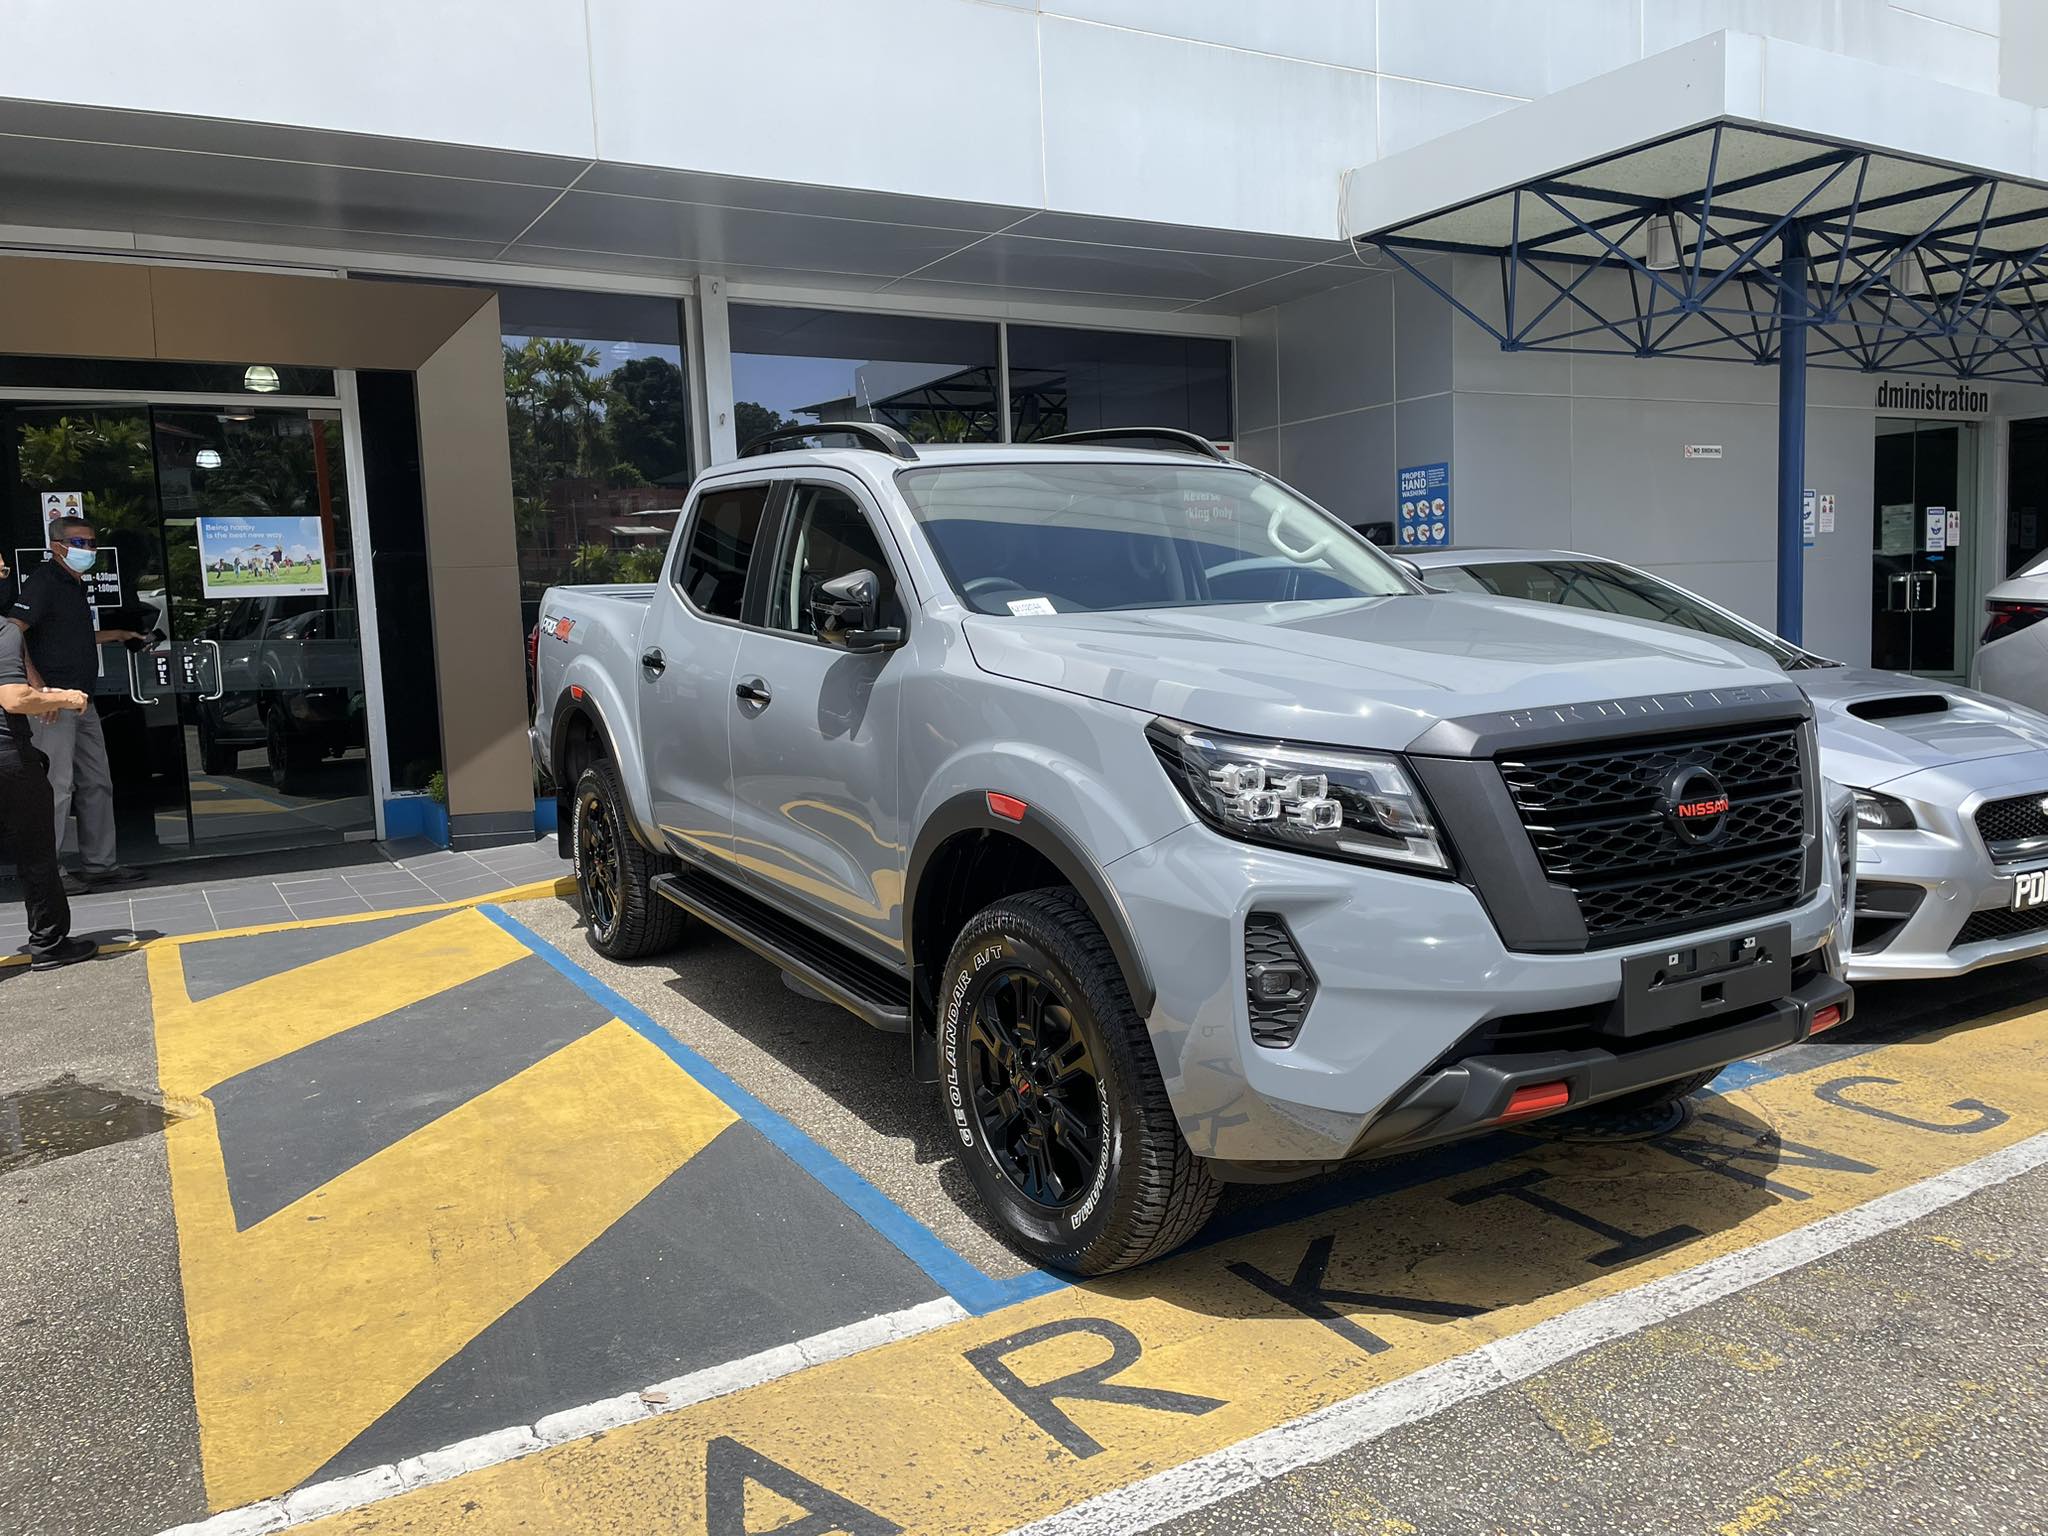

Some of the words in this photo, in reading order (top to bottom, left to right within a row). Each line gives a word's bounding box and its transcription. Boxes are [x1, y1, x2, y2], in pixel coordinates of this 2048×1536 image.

[1875, 380, 1988, 412] dministration
[1401, 470, 1426, 480] PROPER
[1401, 478, 1427, 491] HAND
[1401, 488, 1427, 498] WASHING
[205, 524, 229, 532] Being
[230, 524, 256, 532] happy
[157, 657, 167, 685] PULL
[184, 656, 194, 683] PULL
[1678, 799, 1729, 817] NISSAN
[945, 970, 973, 1148] GEOLANDAR
[973, 944, 1003, 972] A/T
[1071, 1078, 1111, 1230] YOKOHAMA
